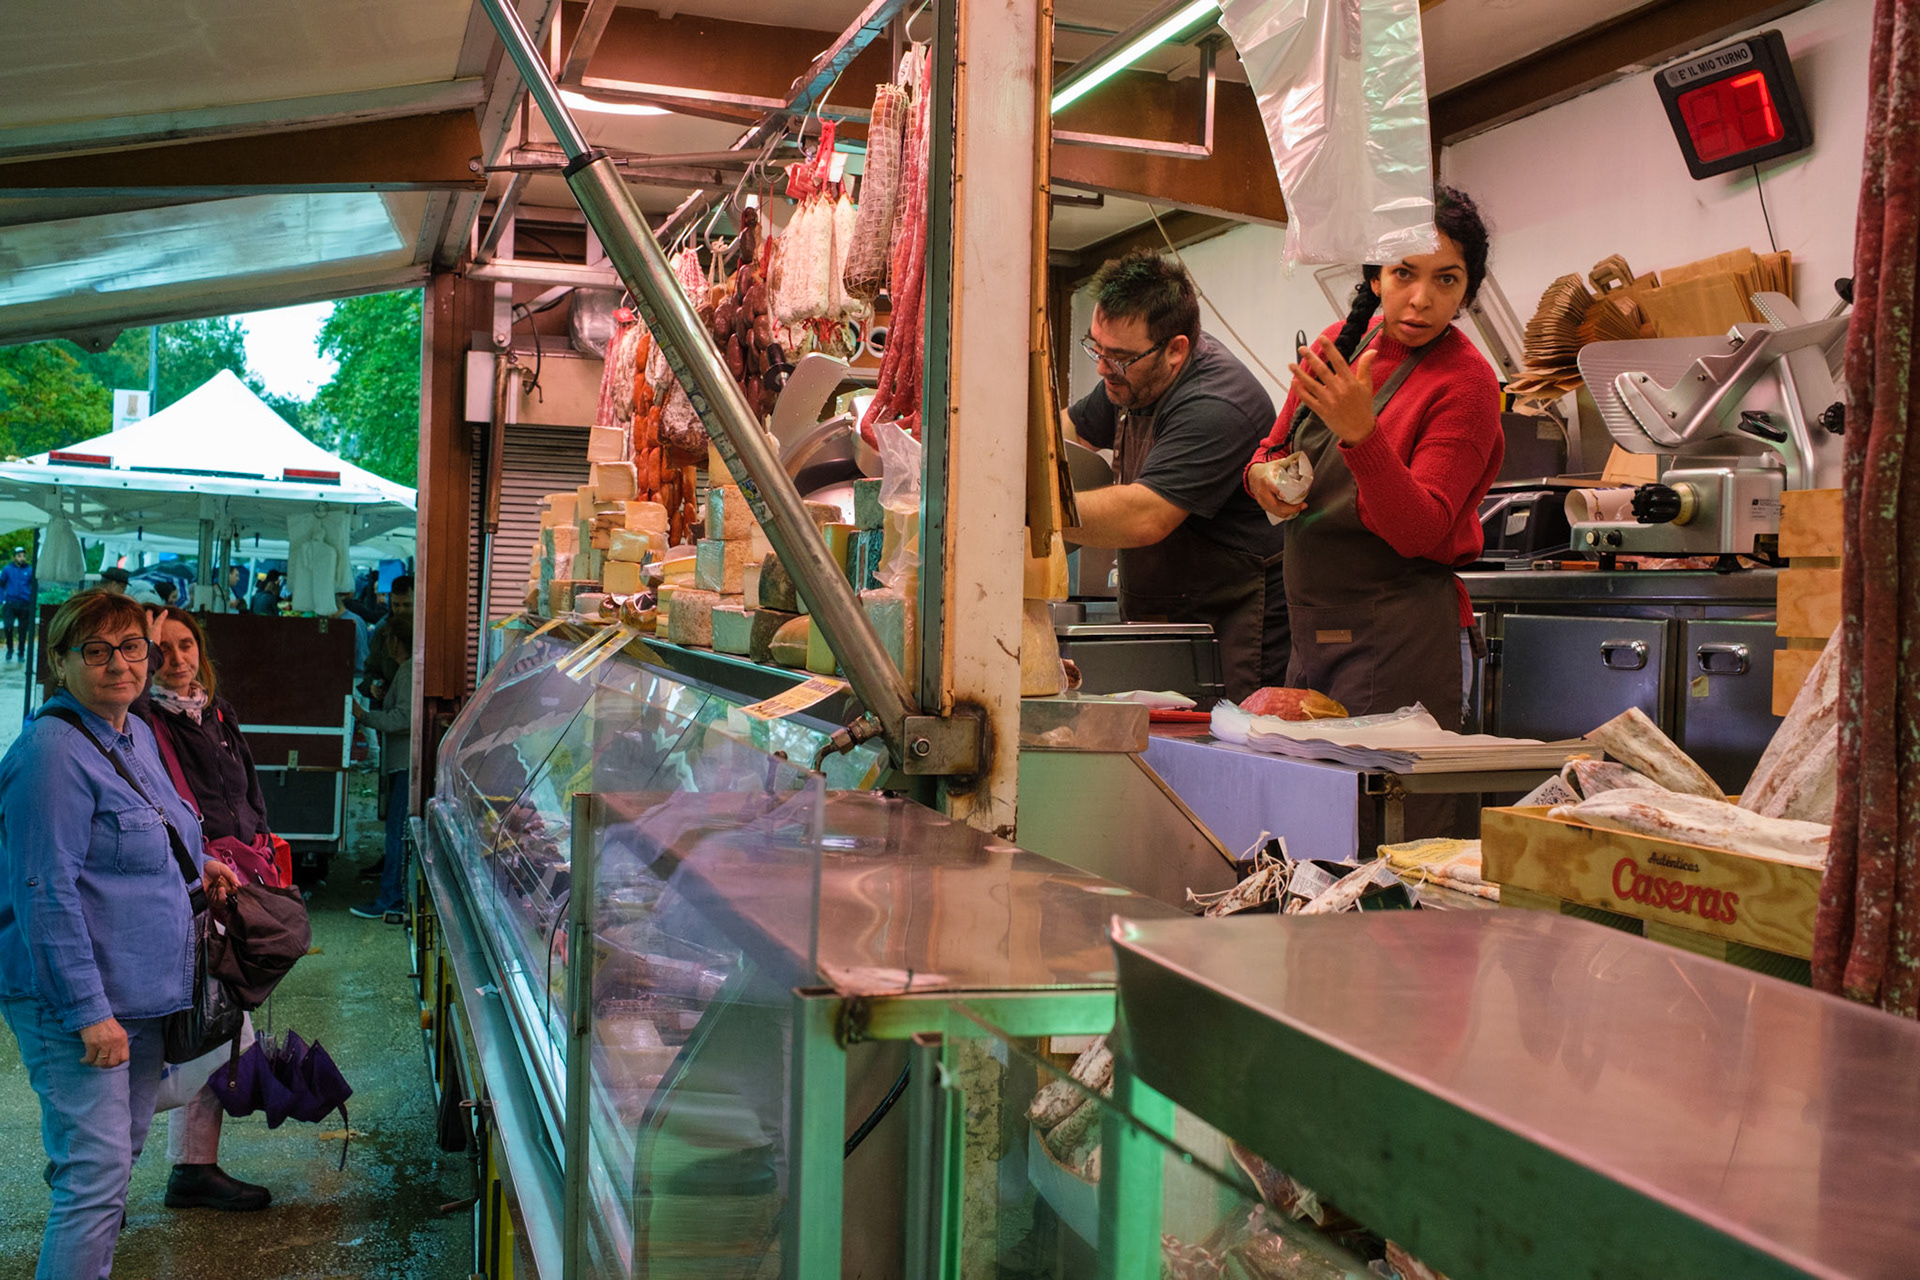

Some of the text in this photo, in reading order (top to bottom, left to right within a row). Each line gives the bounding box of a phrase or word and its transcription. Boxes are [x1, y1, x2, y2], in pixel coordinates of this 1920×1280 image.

[1687, 66, 1698, 77] IL
[1698, 60, 1716, 74] MIO
[1716, 48, 1748, 66] TURNO
[1730, 71, 1776, 138] 7
[1612, 857, 1739, 925] Caseras
